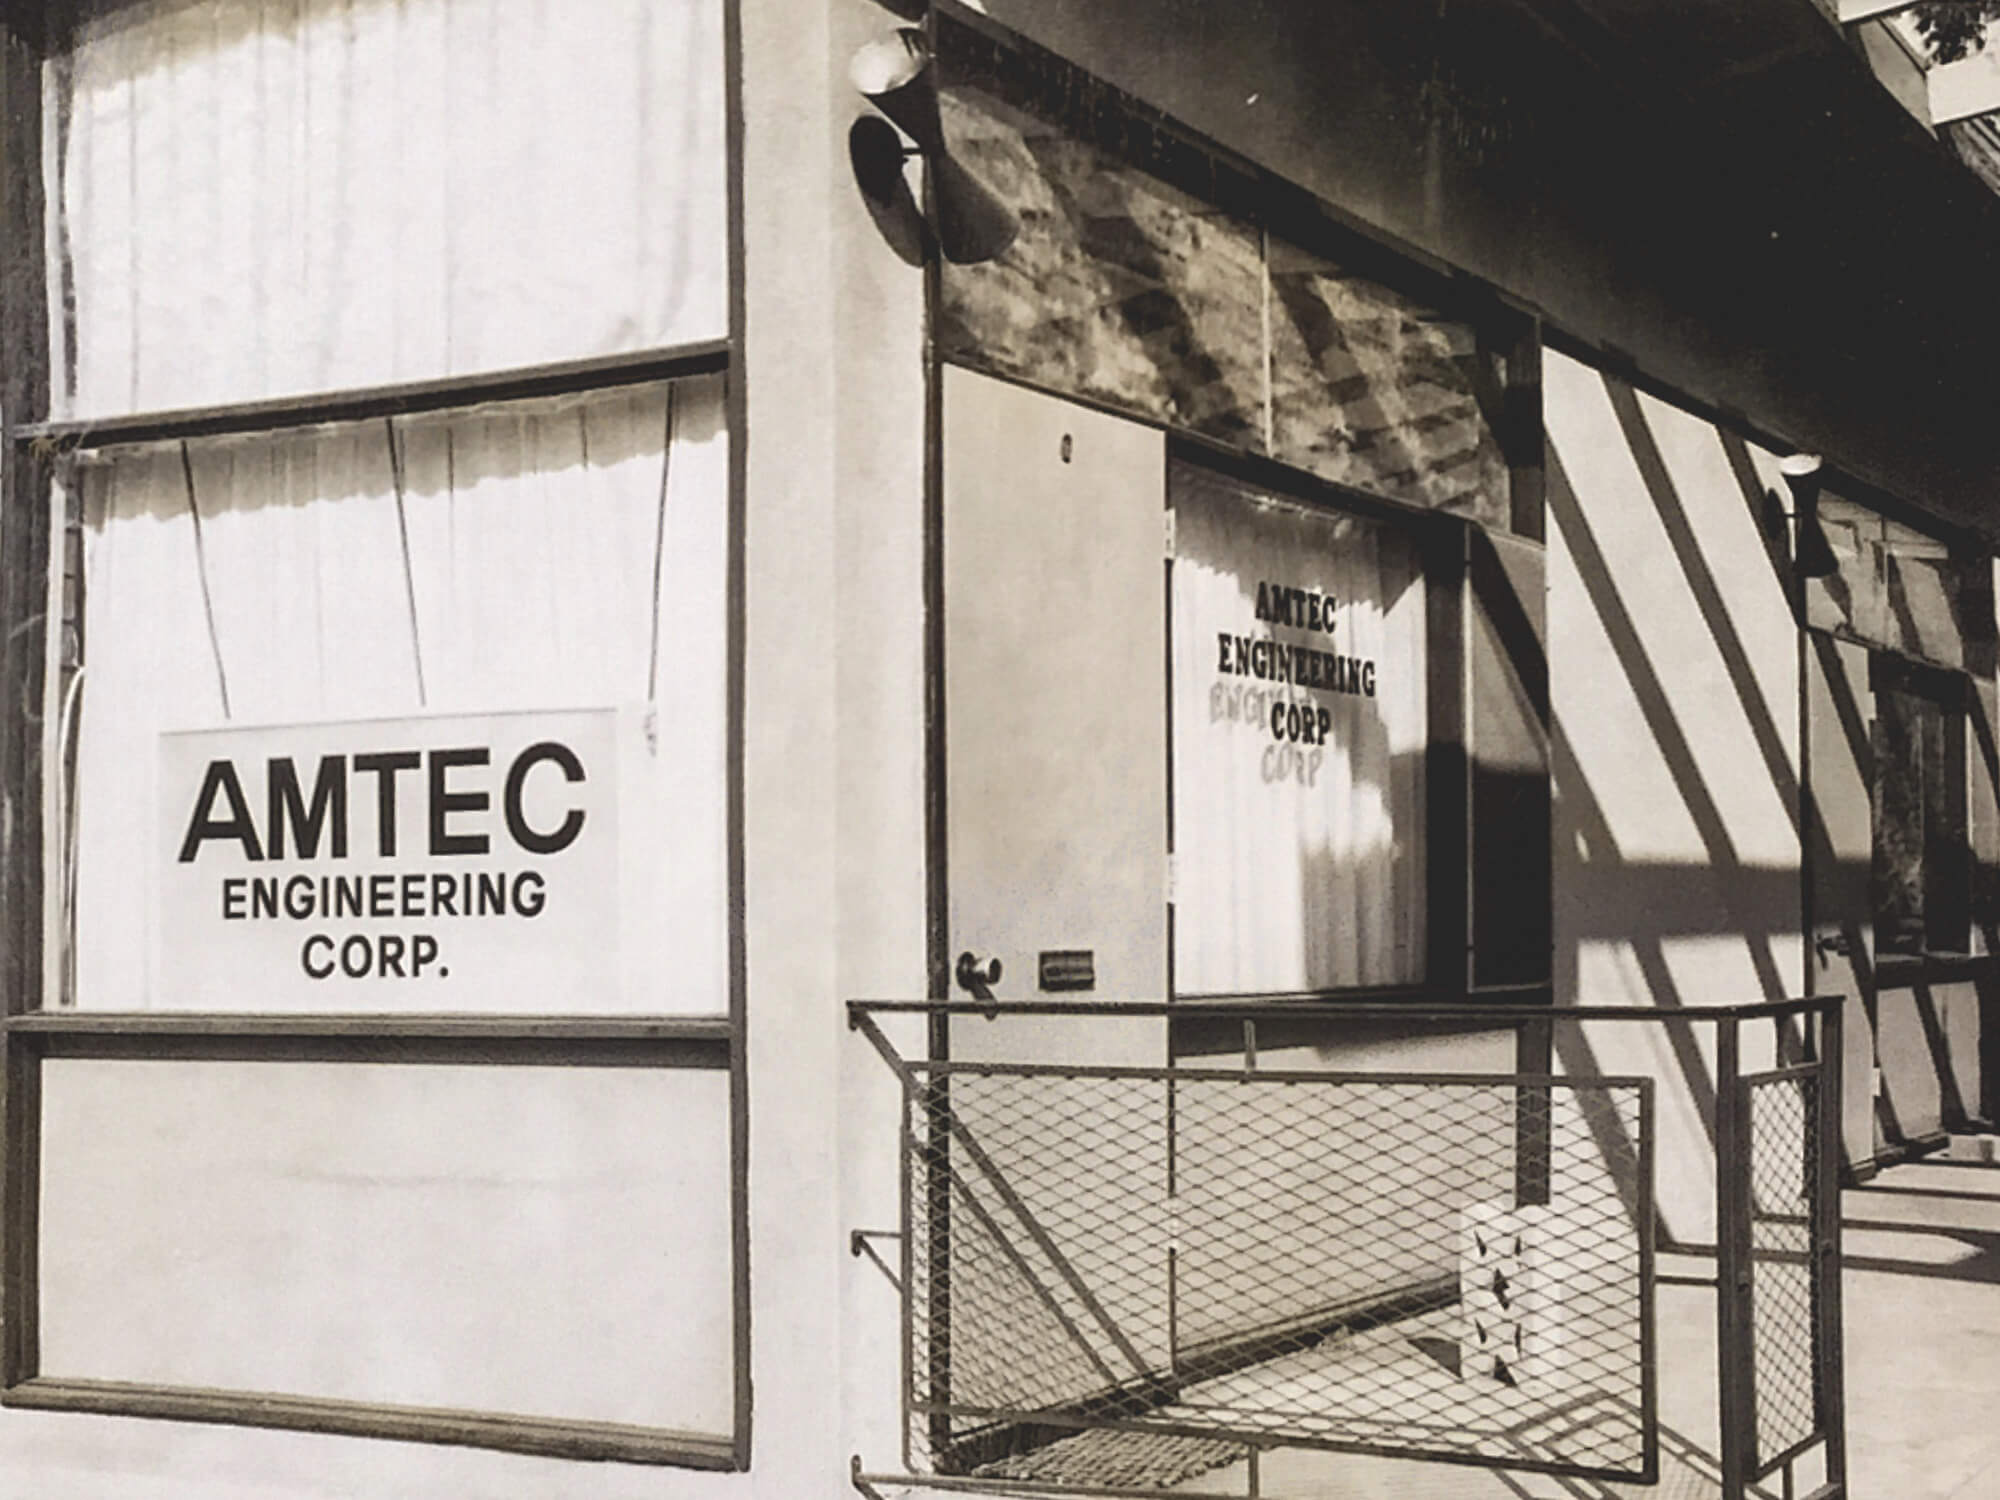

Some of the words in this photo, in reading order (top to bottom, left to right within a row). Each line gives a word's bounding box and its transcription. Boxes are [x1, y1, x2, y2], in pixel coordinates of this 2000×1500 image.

[1255, 580, 1336, 634] AMTEC
[1218, 632, 1376, 697] ENGINEERING
[1270, 701, 1332, 746] CORP
[178, 741, 587, 863] AMTEC
[222, 870, 547, 920] ENGINEERING
[301, 934, 449, 980] CORP.
